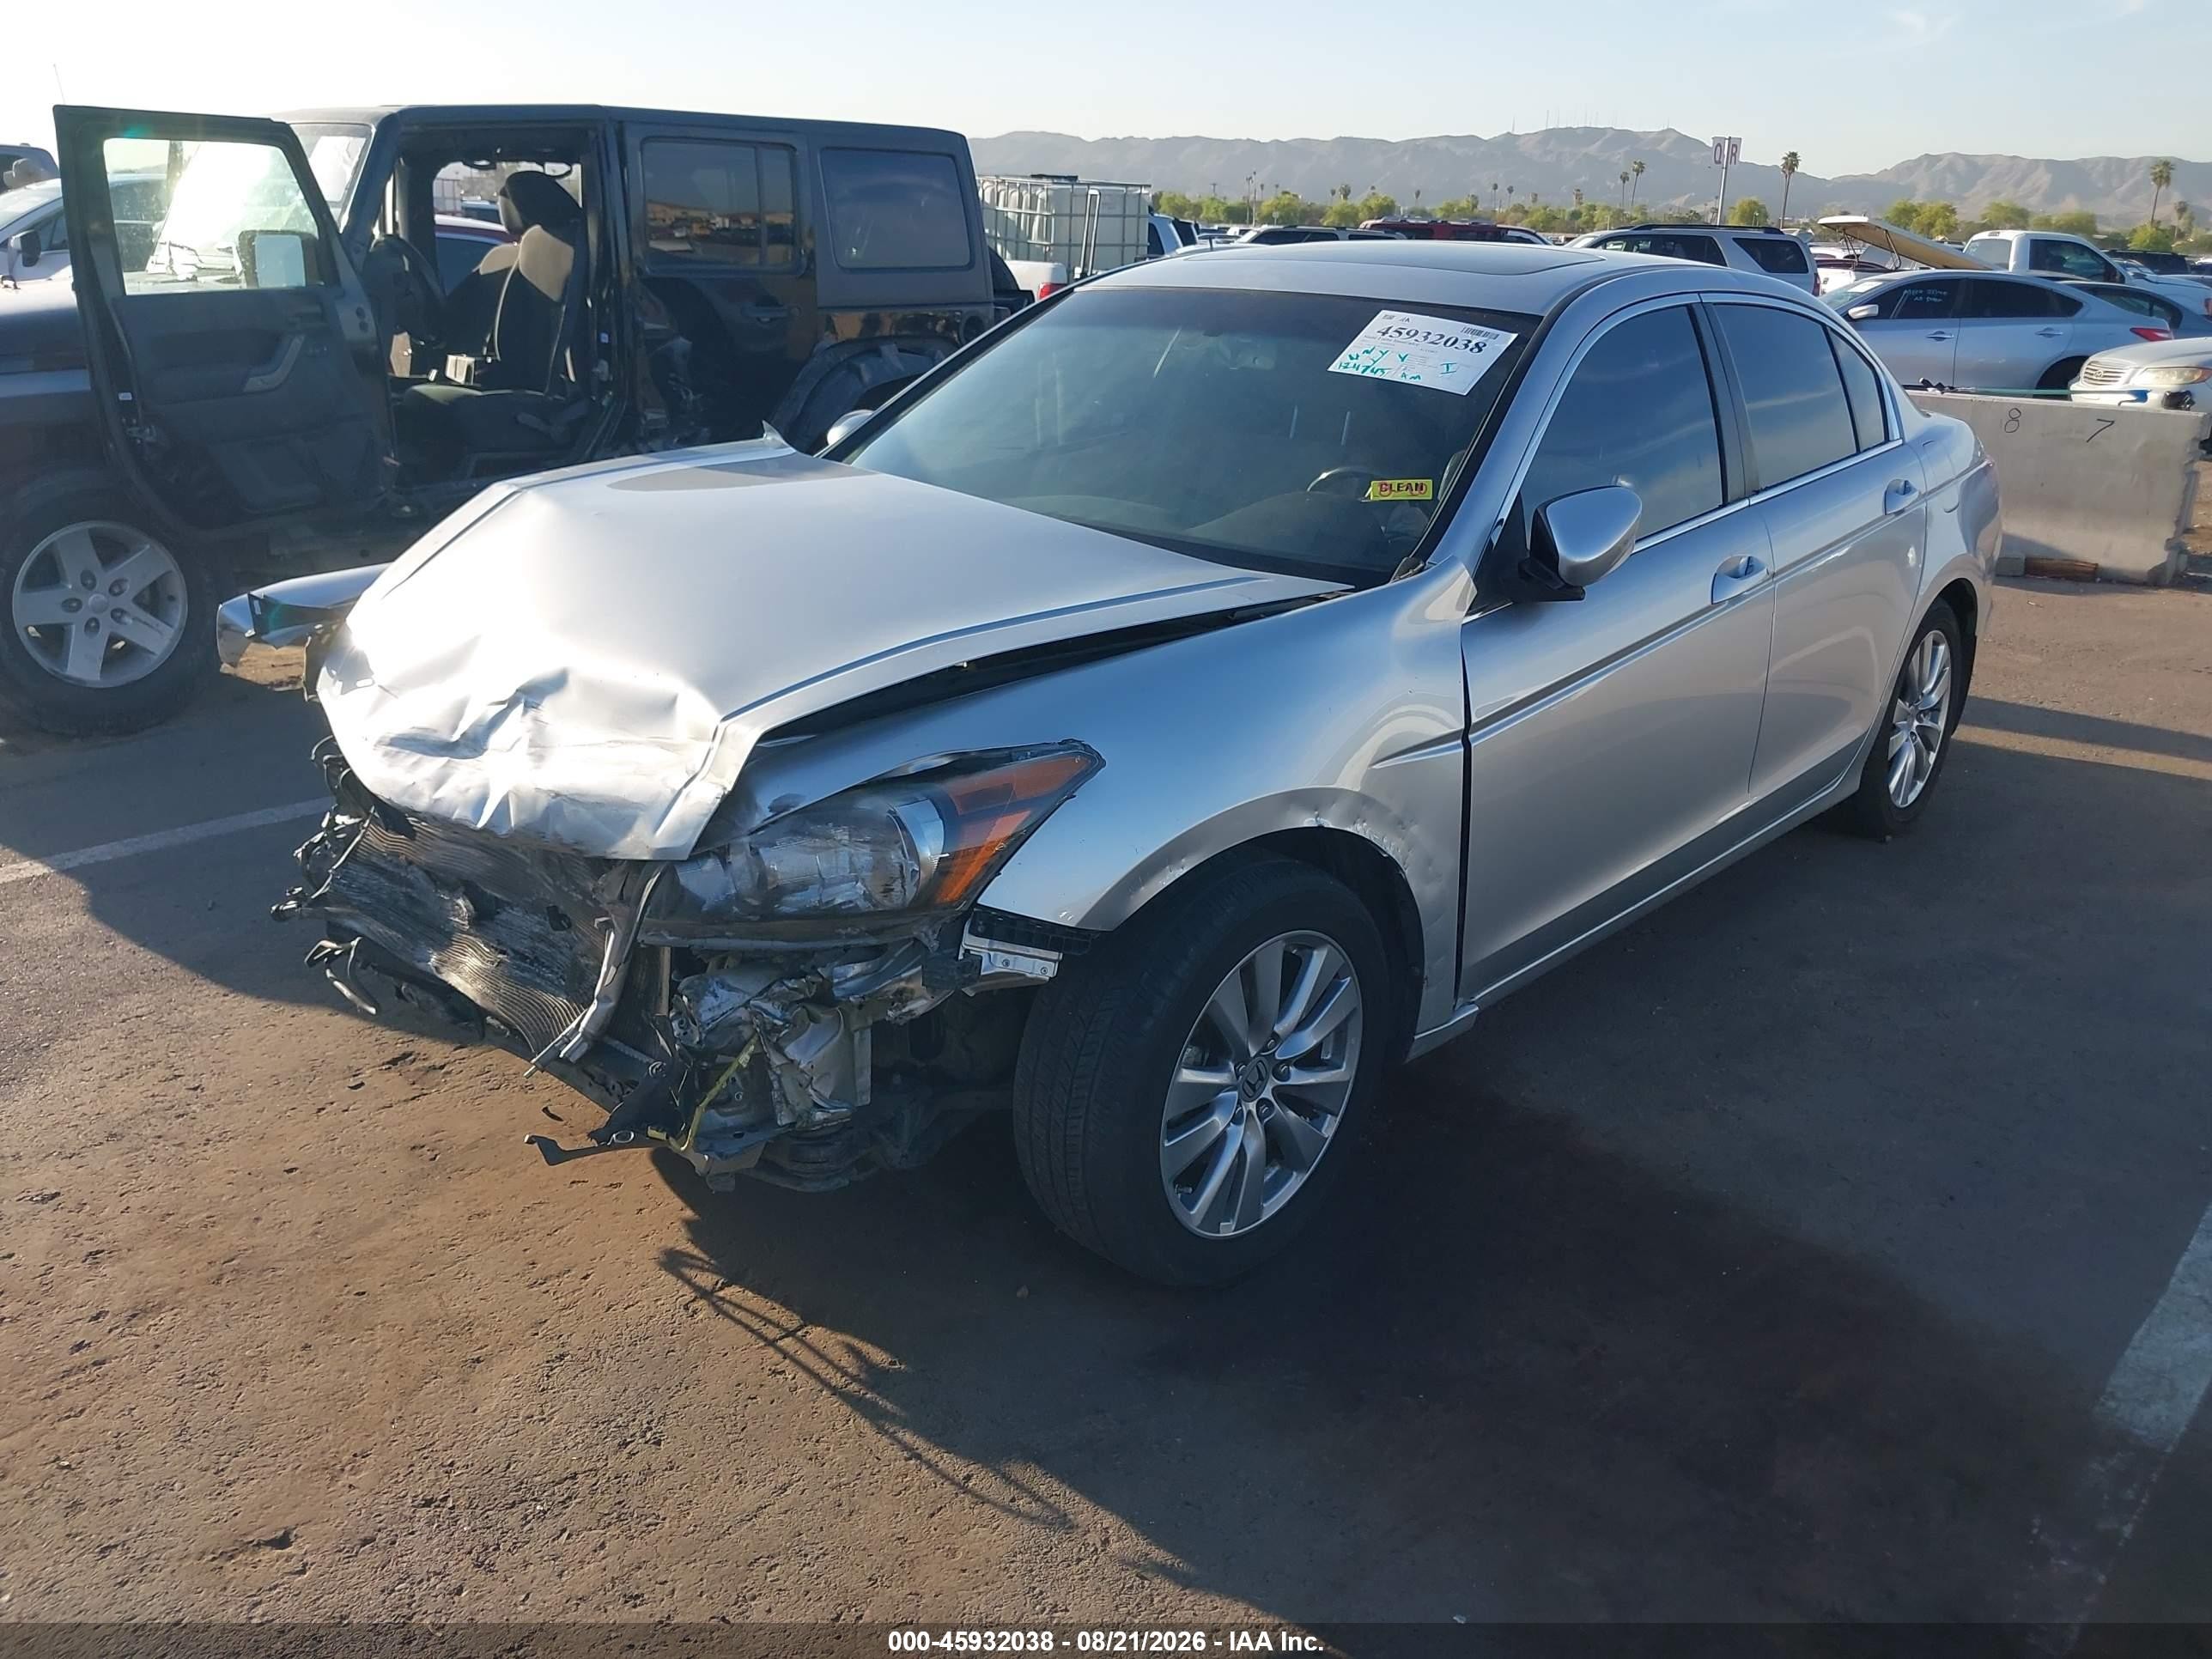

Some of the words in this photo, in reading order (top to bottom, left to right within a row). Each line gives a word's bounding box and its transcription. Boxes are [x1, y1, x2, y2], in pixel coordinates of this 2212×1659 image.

[1714, 143, 1723, 164] Q
[1729, 144, 1737, 165] R
[1377, 325, 1487, 353] 45932038
[2004, 408, 2021, 434] 8
[2086, 418, 2115, 443] 7
[1380, 483, 1424, 492] CLEAN
